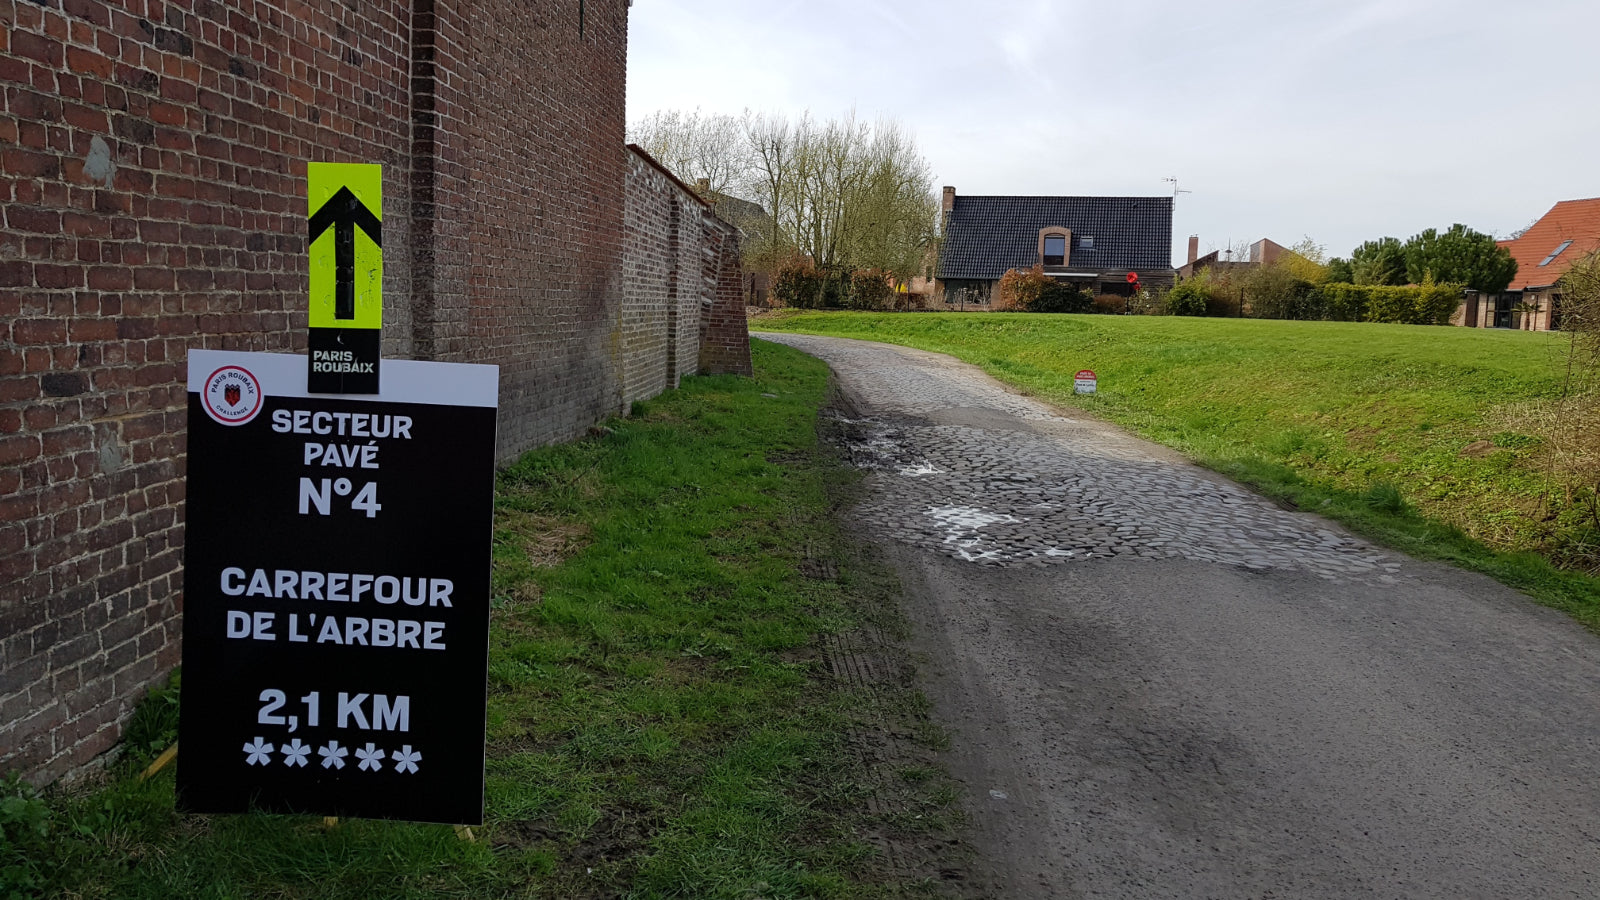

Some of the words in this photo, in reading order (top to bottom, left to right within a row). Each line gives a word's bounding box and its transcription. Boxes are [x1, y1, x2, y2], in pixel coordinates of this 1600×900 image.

[313, 350, 353, 361] PARIS
[313, 361, 374, 373] ROUBAIX
[211, 374, 227, 393] PARIS
[228, 372, 254, 395] ROUBAIX
[216, 405, 248, 416] CHALLENGE
[271, 409, 413, 440] SECTEUR
[304, 440, 379, 469] PAVÉ
[220, 567, 454, 608] CARREFOUR
[226, 610, 276, 641] DE
[288, 613, 446, 650] L'ARBRE
[257, 688, 319, 733] 2,1
[337, 692, 410, 732] KM
